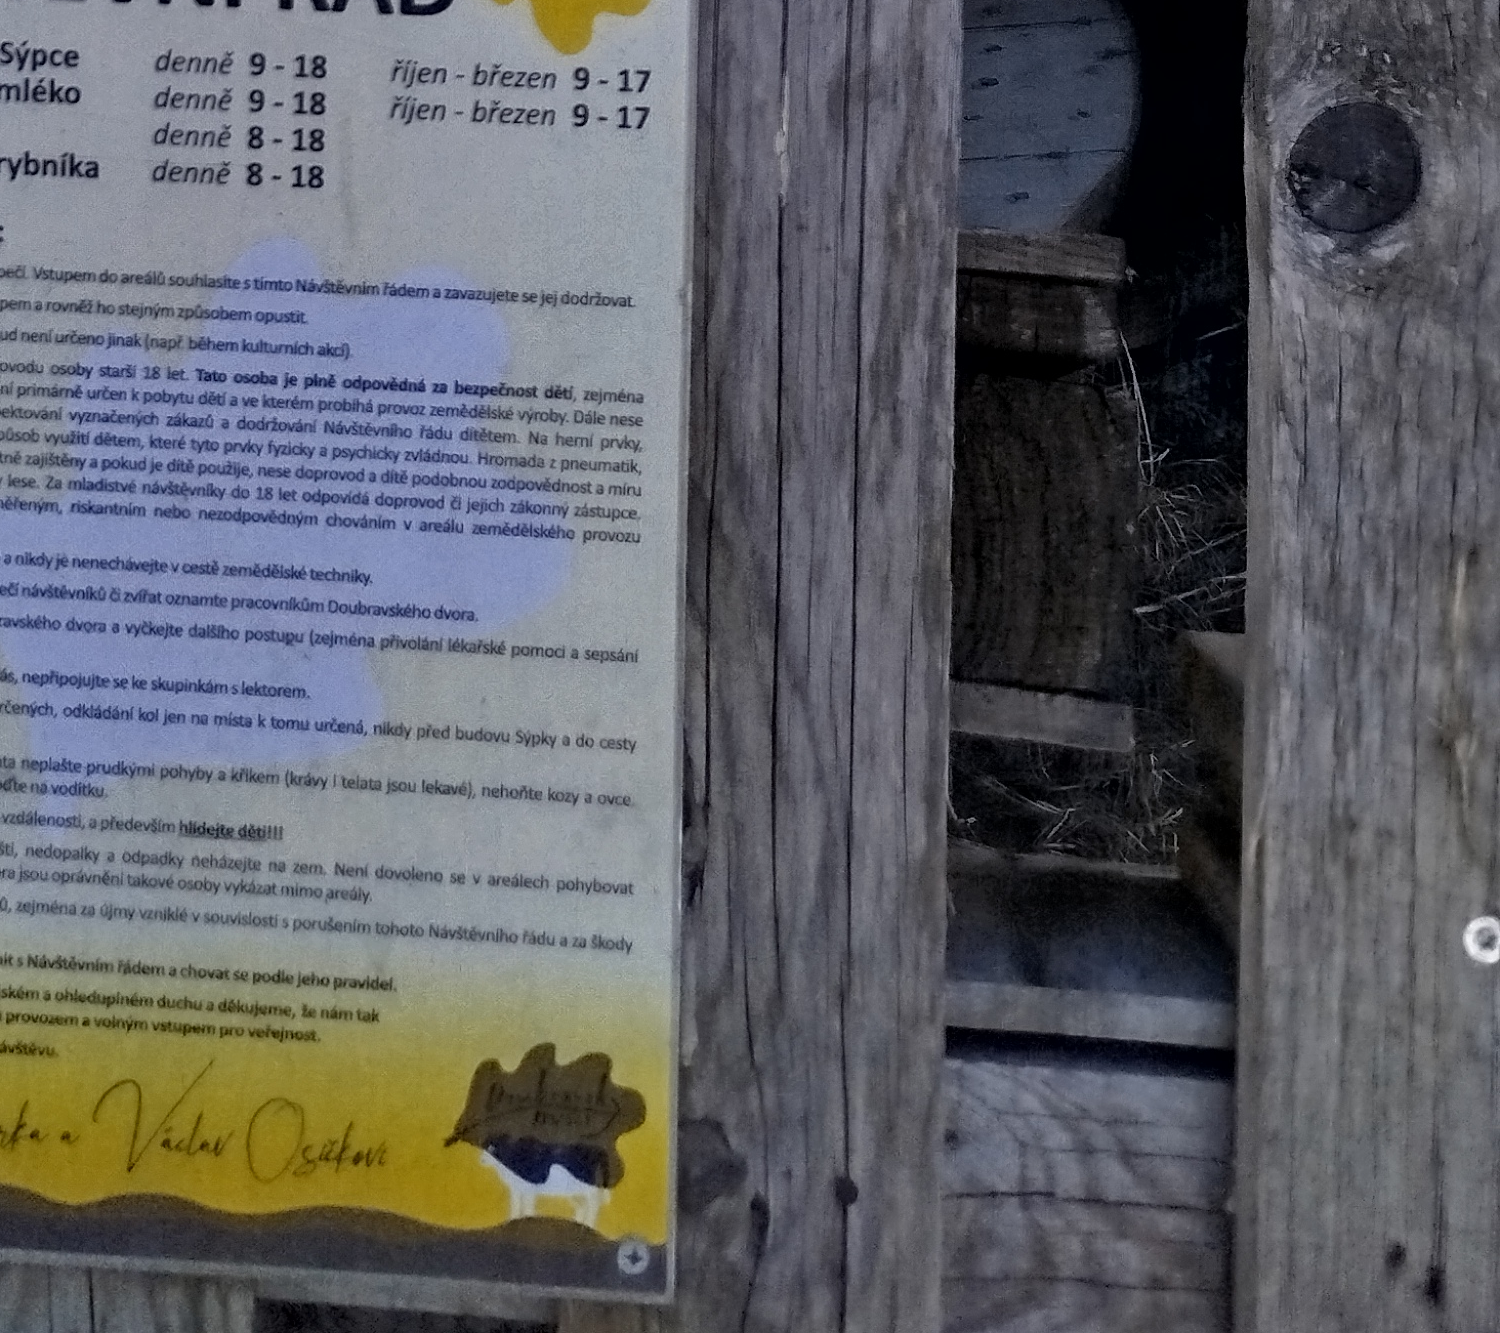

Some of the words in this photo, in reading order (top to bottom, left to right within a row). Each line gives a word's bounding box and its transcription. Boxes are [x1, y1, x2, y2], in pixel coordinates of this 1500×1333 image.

[153, 48, 234, 75] denně
[248, 51, 266, 77] 9
[294, 54, 327, 79] 18
[390, 58, 448, 88] říjen
[471, 62, 557, 90] březen
[572, 66, 590, 91] 9
[617, 68, 652, 93] 17
[153, 85, 233, 112] denně
[247, 88, 265, 114] 9
[292, 90, 326, 116] 18
[389, 95, 446, 125] říjen
[470, 99, 556, 126] březen
[571, 102, 590, 128] 9
[616, 104, 650, 130] 17
[152, 121, 232, 148] denně
[246, 124, 264, 150] 8
[292, 127, 325, 153] 18
[151, 158, 231, 186] denně
[245, 161, 264, 187] 8
[291, 164, 325, 189] 18
[21, 669, 111, 691] nepřipojujte
[112, 677, 129, 691] se
[130, 674, 148, 691] ke
[150, 676, 229, 695] skupinkám
[230, 684, 240, 696] s
[87, 818, 98, 830] a
[99, 815, 176, 835] především
[178, 819, 237, 839] hlídejte
[60, 1130, 80, 1146] a
[93, 1060, 234, 1173] Václav
